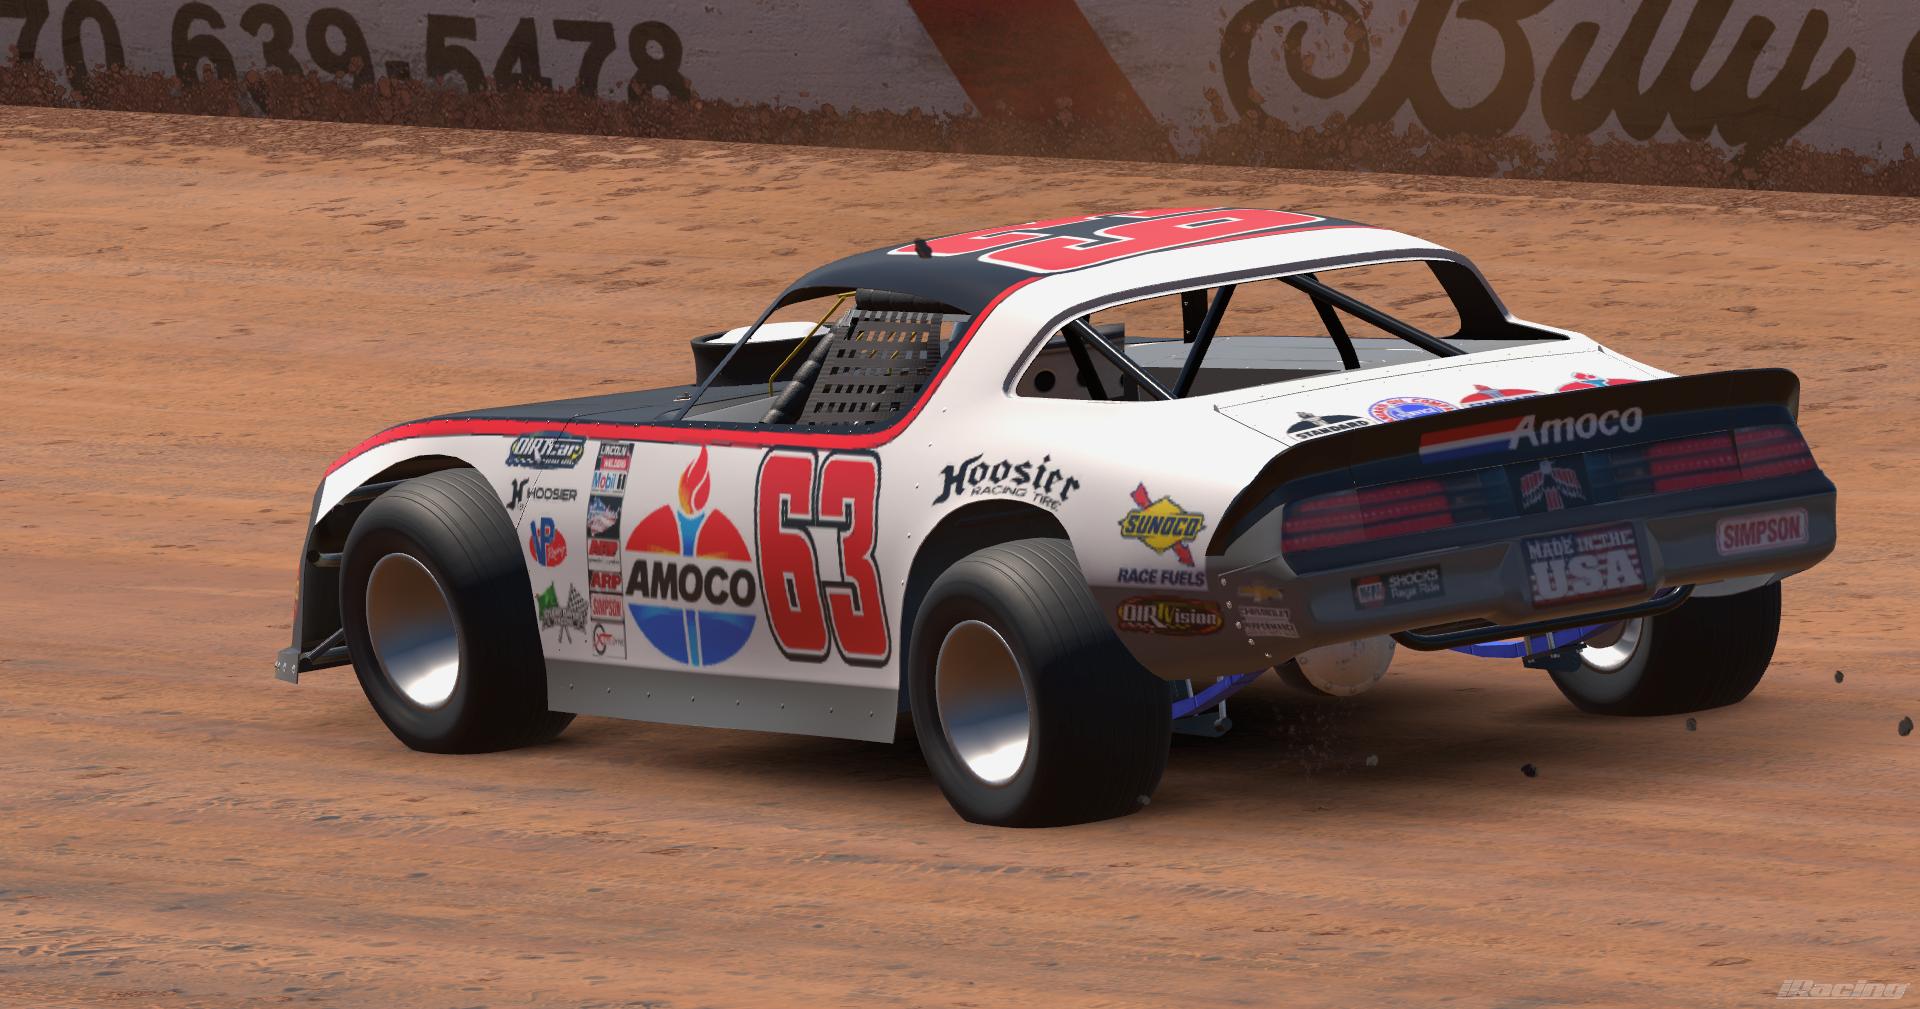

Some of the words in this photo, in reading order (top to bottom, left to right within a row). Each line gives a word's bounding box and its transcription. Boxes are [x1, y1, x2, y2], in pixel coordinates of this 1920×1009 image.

[172, 4, 698, 102] 639-5478
[1296, 420, 1369, 440] STANDARD
[1509, 407, 1643, 450] Amoco
[600, 445, 627, 456] LINCOLN
[593, 470, 616, 489] Mobil
[932, 453, 1080, 506] Hoosier
[526, 487, 577, 501] HOOSIER
[970, 485, 1028, 497] RACING
[1033, 491, 1062, 512] TIRE
[1124, 515, 1200, 537] SUNOCO
[1722, 515, 1801, 550] SIMPSON
[530, 517, 555, 567] VP
[1527, 534, 1575, 558] MADE
[1599, 529, 1635, 547] THE
[754, 446, 892, 668] 63
[591, 571, 622, 589] ARP
[625, 559, 756, 607] AMOCO
[1117, 568, 1158, 584] RACE
[1161, 569, 1206, 586] FUELS
[1531, 549, 1643, 600] USA
[593, 597, 622, 617] SIMPSON
